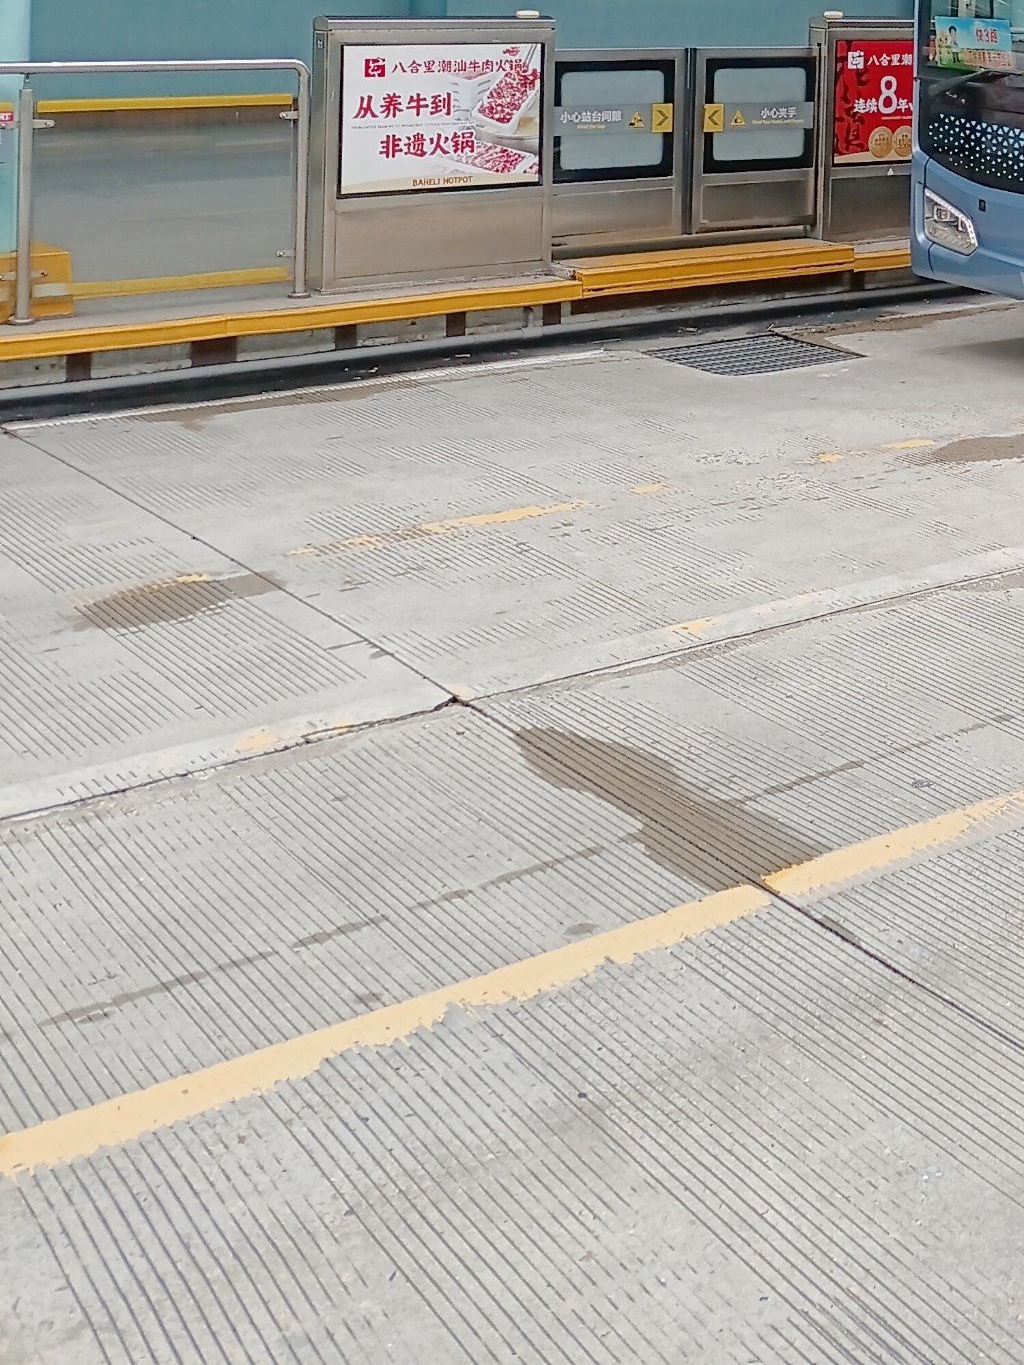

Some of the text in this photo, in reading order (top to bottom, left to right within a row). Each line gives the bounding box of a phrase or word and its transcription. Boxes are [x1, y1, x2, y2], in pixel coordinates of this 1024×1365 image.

[392, 59, 523, 74] 八合里潮汕牛肉火锅
[353, 92, 452, 119] 从养牛到
[760, 106, 797, 119] 小心夹手
[379, 131, 475, 158] 非遗火锅
[412, 175, 473, 186] BAHELI HOTPOT
